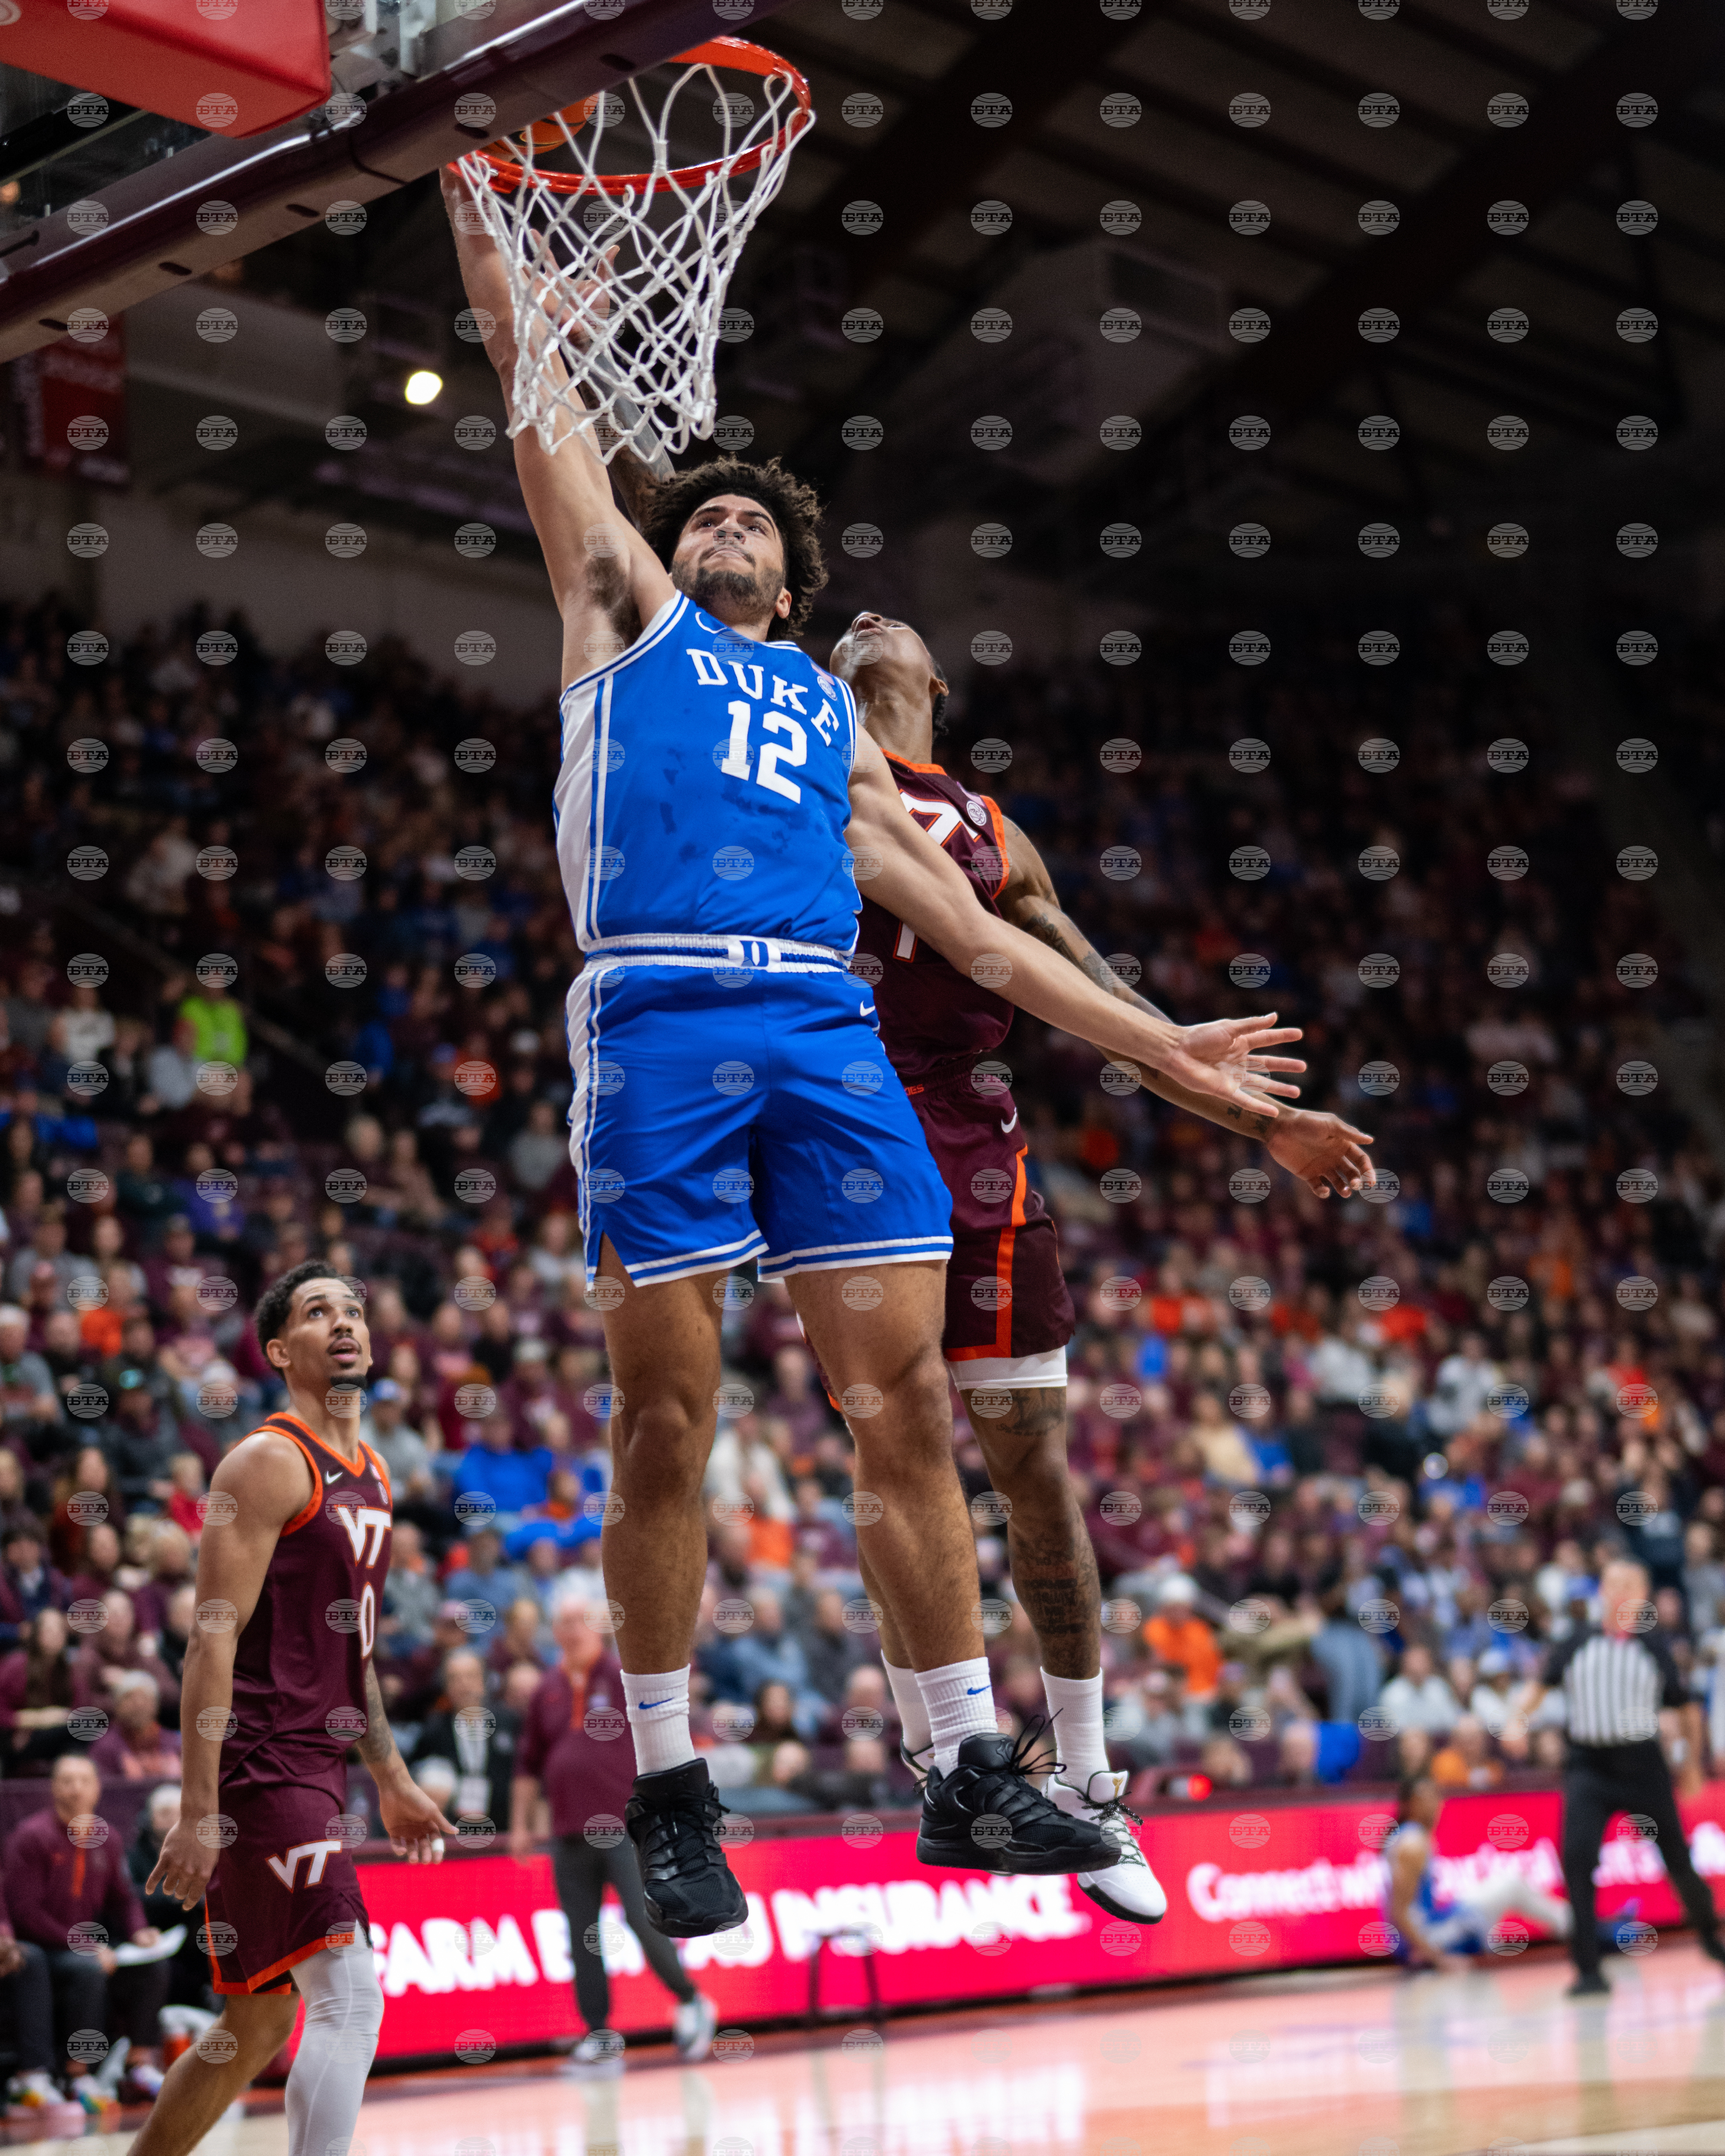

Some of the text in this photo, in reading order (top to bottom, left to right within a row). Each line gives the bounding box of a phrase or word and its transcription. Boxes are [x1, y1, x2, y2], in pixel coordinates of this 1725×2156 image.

[686, 648, 840, 747] DUKE
[721, 700, 807, 804] 12
[334, 1504, 392, 1569] VT
[360, 1582, 375, 1659] 0
[265, 1839, 342, 1893] VT
